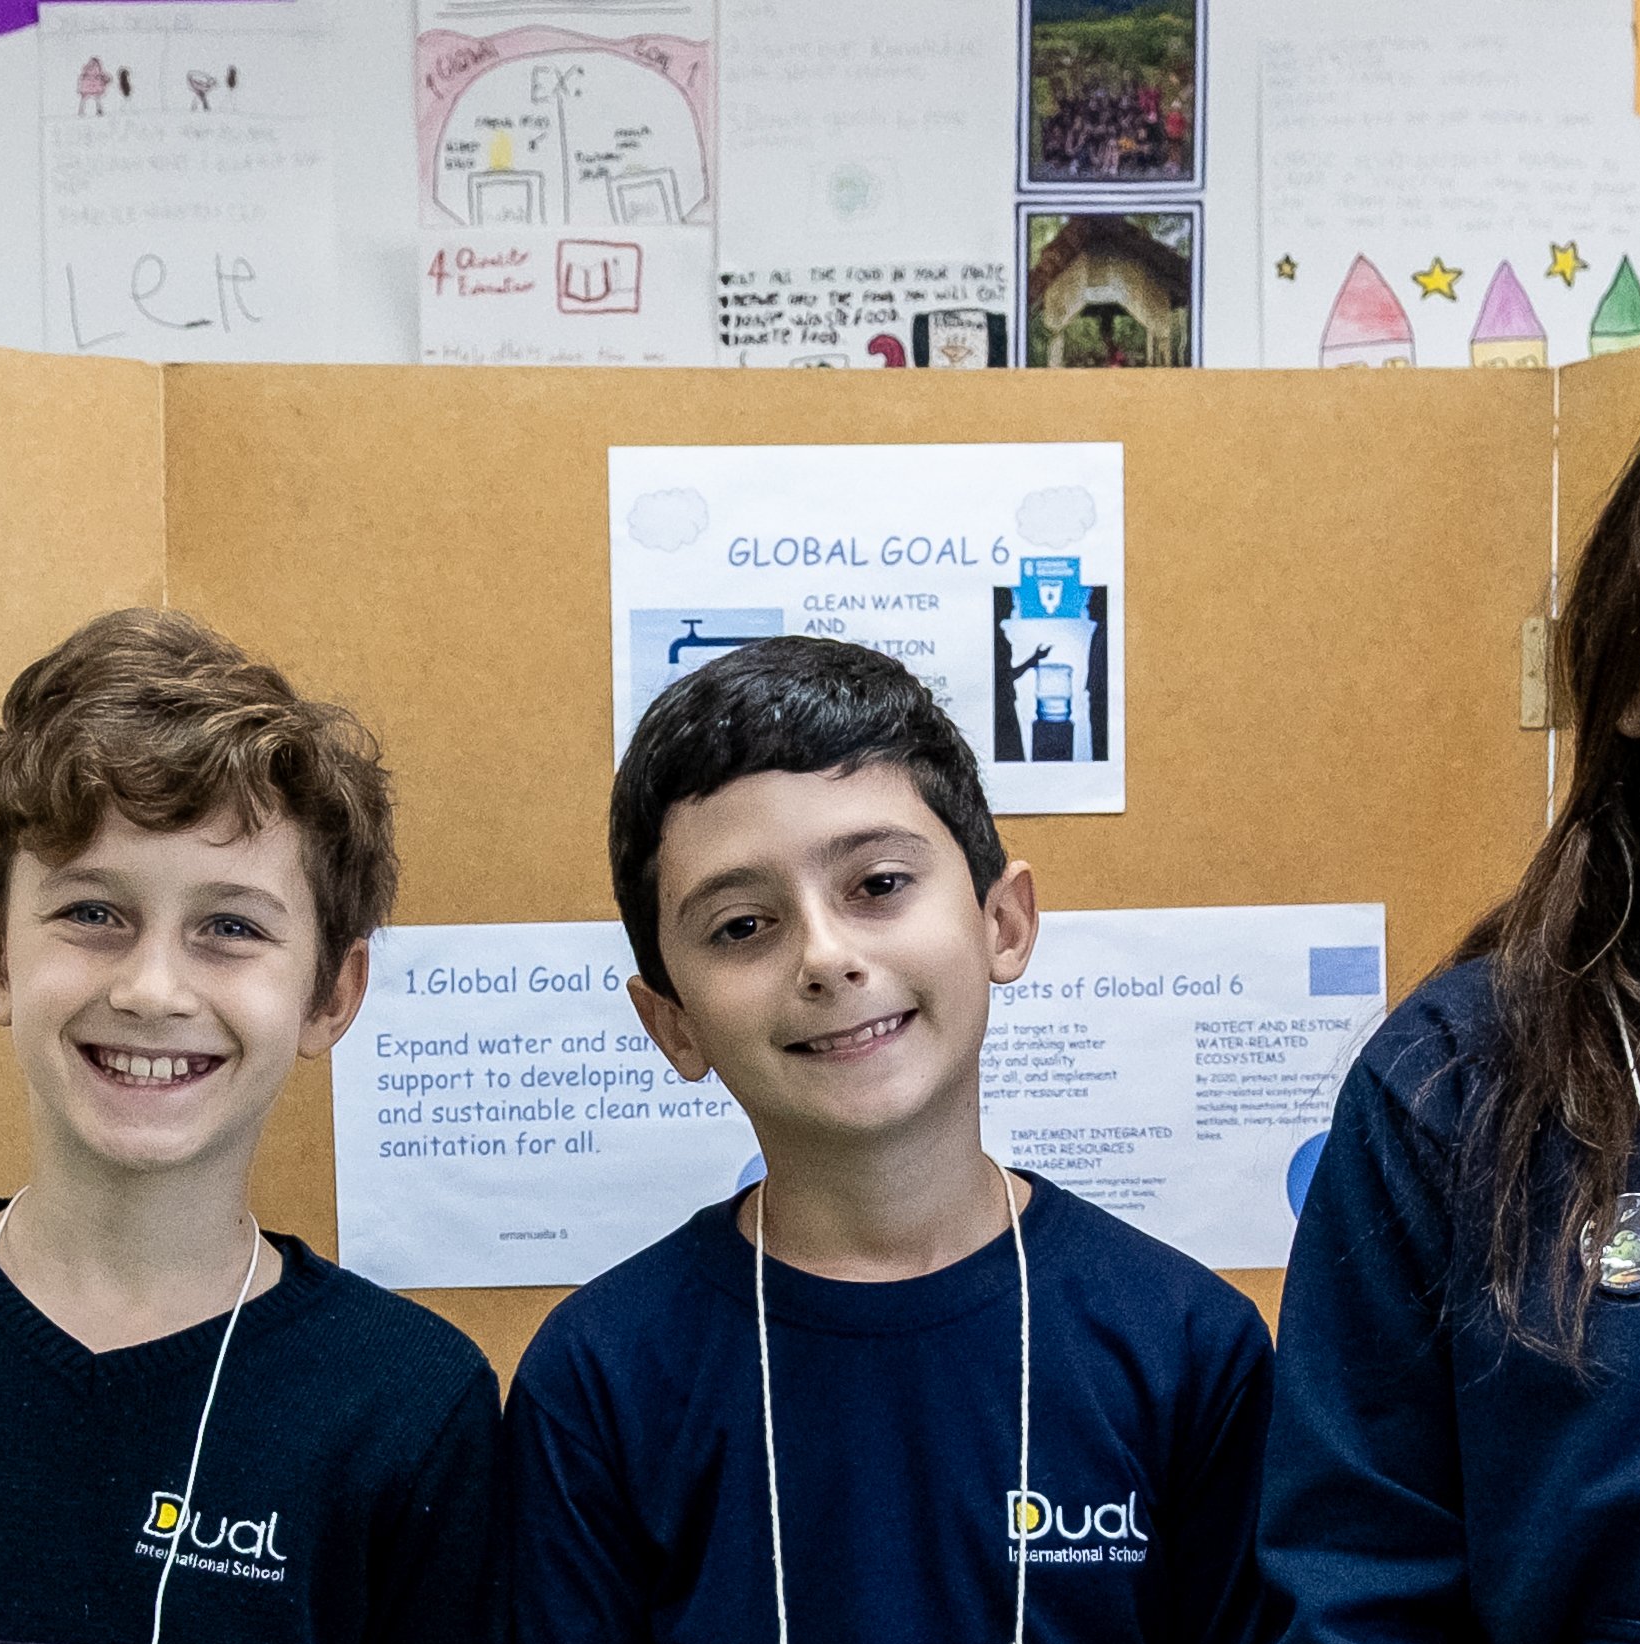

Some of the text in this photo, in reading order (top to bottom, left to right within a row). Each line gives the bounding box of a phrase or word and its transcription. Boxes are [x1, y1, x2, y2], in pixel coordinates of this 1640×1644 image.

[728, 535, 1010, 567] GLOBAL GOAL 6
[803, 594, 940, 611] CLEAN WATER
[804, 618, 845, 634] AND
[529, 965, 590, 992] Goal
[603, 965, 620, 992] 6
[1061, 977, 1085, 999] of
[1094, 974, 1163, 999] Global
[1173, 973, 1221, 996] Goal
[1230, 974, 1243, 995] 6
[1014, 1023, 1088, 1038] target to
[1195, 1019, 1351, 1033] PROTECT AND RESTORE
[377, 1032, 469, 1063] Expand
[479, 1034, 551, 1054] water
[561, 1030, 606, 1054] and
[1013, 1039, 1106, 1052] drinking water
[1197, 1036, 1308, 1049] WATER-RELATED
[1005, 1053, 1076, 1067] and quality
[1195, 1052, 1286, 1065] ECOSYSTEMS
[377, 1064, 655, 1096] support to developing
[1024, 1070, 1118, 1084] and implement
[983, 1089, 1020, 1098] water
[378, 1097, 732, 1124] and sustainable clean water
[1011, 1126, 1172, 1140] IMPLEMENT INTEGRATED
[379, 1130, 602, 1158] sanitation for all.
[1012, 1142, 1135, 1155] WATER RESOURCES
[1007, 1490, 1148, 1541] Dual
[143, 1491, 287, 1561] Dual
[232, 1561, 285, 1582] School
